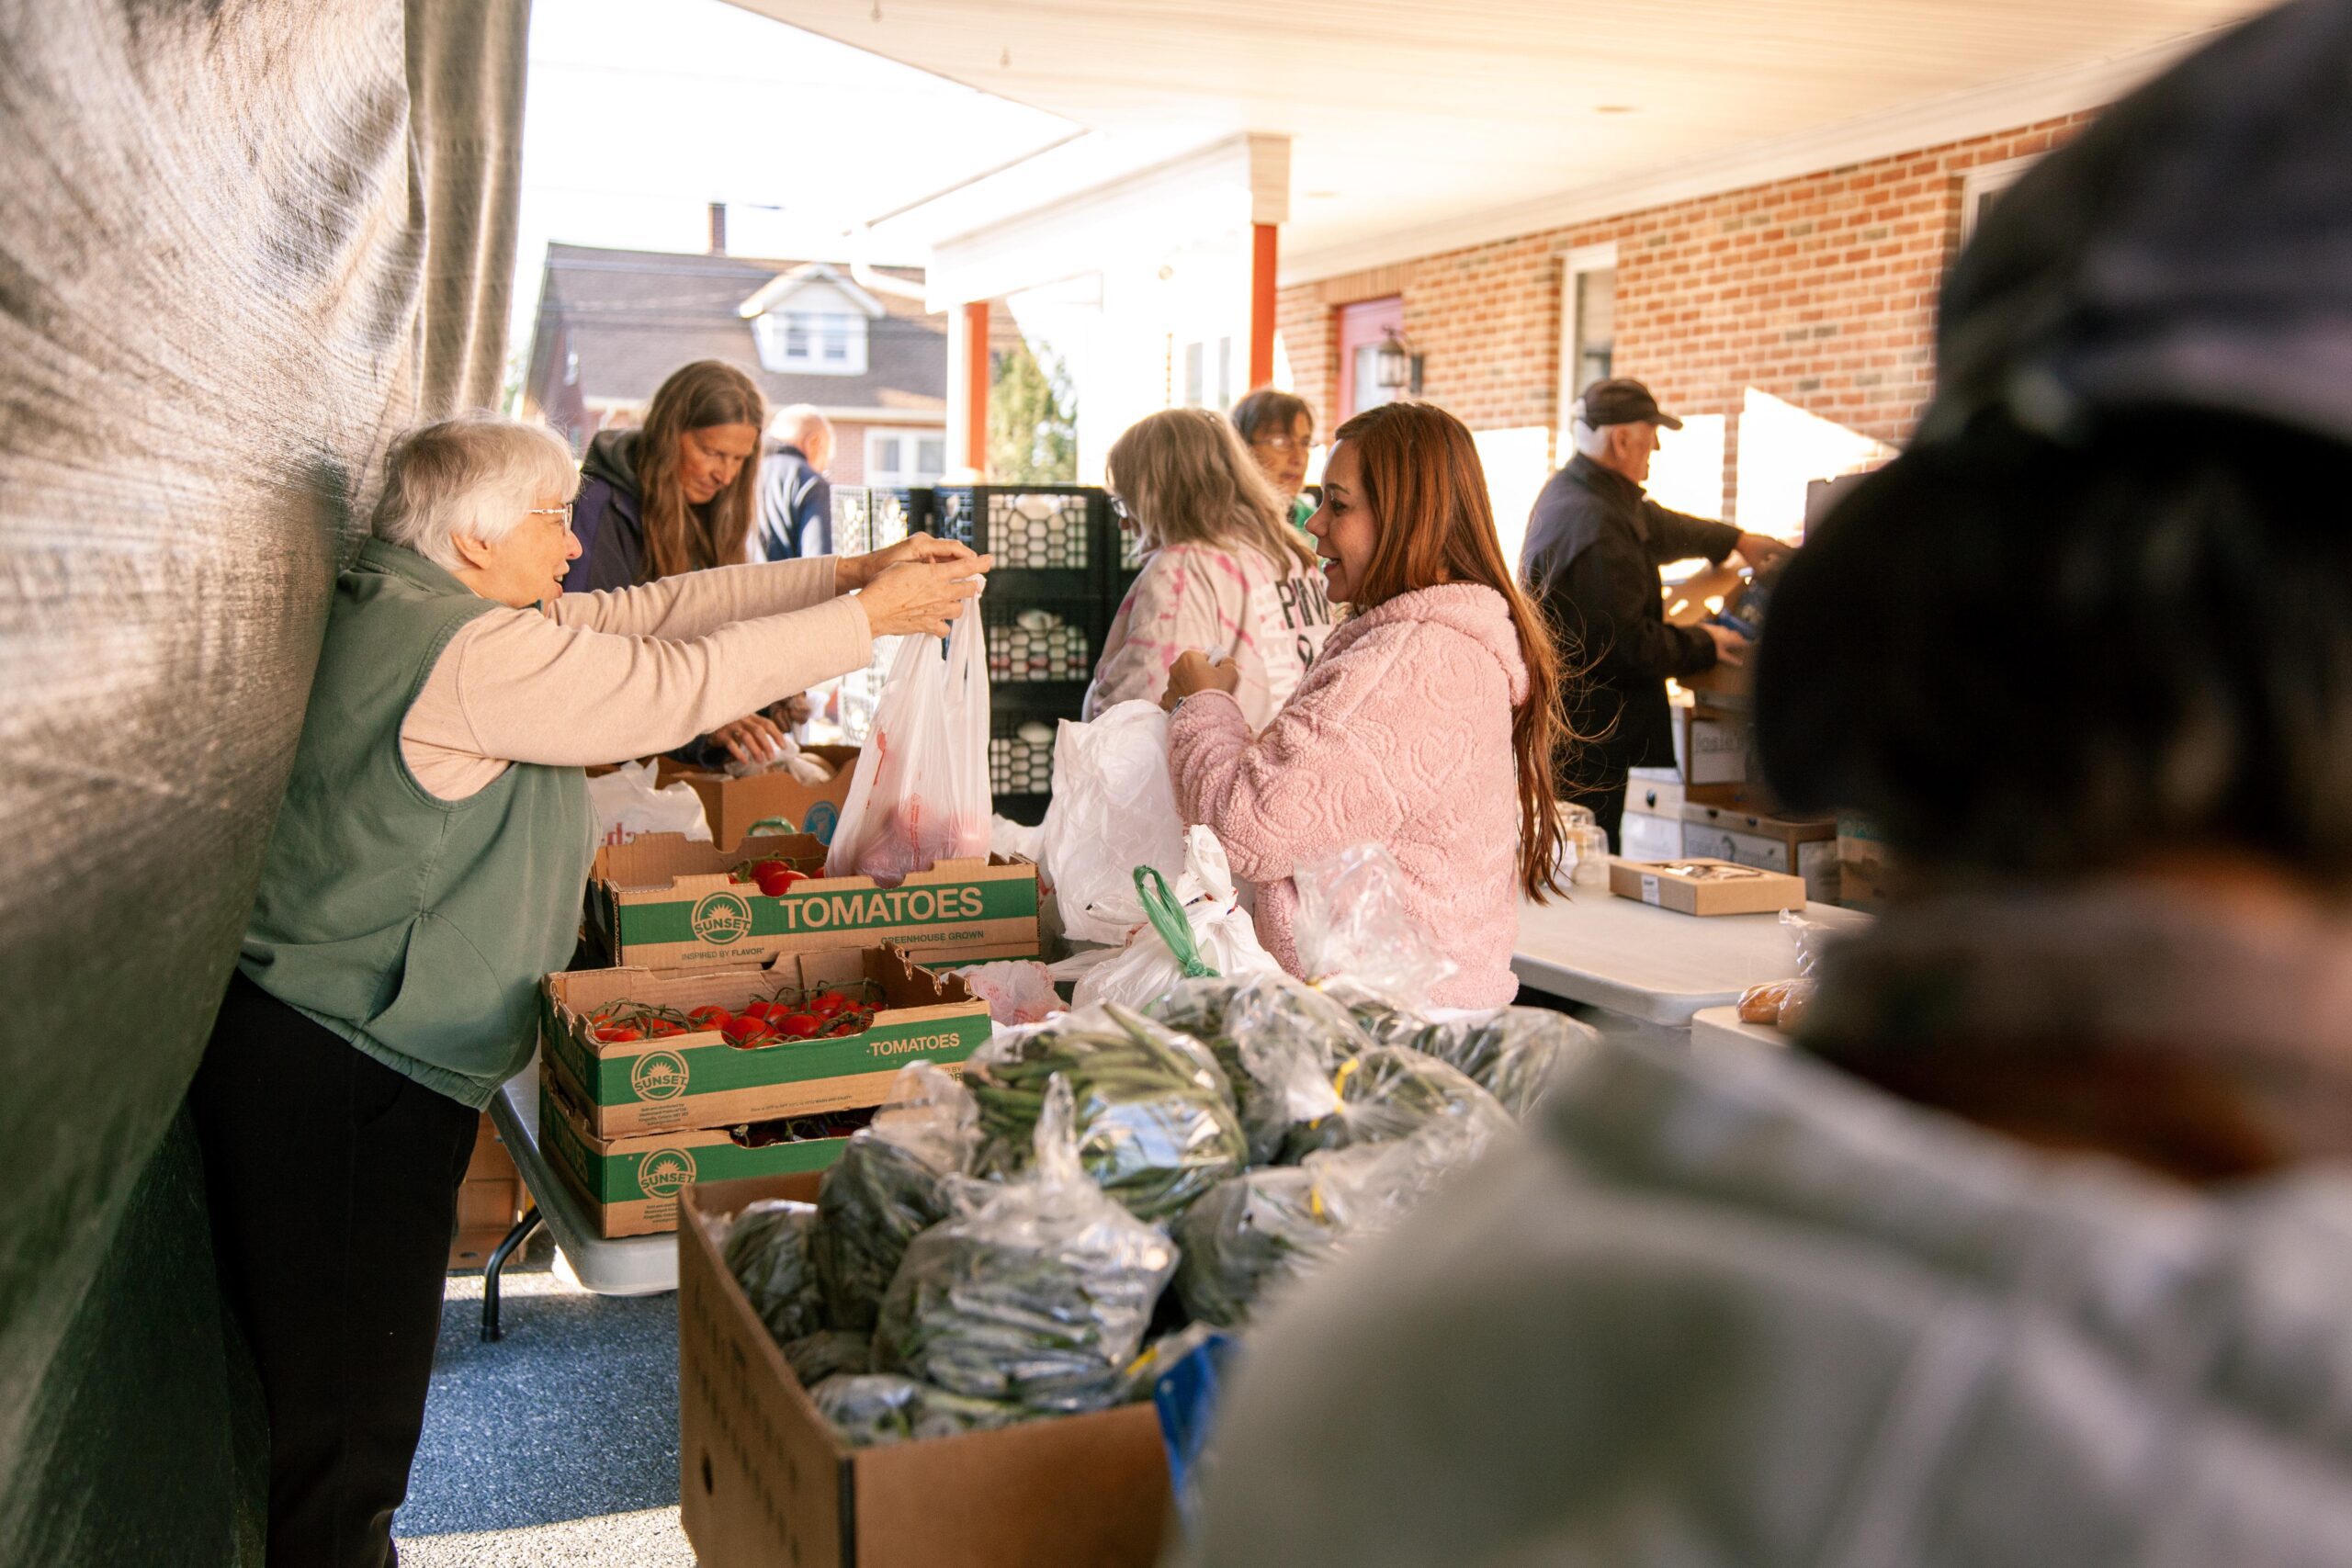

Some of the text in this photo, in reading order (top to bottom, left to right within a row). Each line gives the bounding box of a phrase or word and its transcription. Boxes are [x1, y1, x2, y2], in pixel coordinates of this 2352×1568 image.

[779, 886, 984, 929] TOMATOES
[694, 917, 750, 934] SUNSET
[948, 930, 985, 941] GROWN
[682, 951, 718, 961] INSPIRED
[869, 1032, 960, 1056] TOMATOES
[634, 1075, 687, 1091] SUNSET
[640, 1172, 695, 1189] SUNSET
